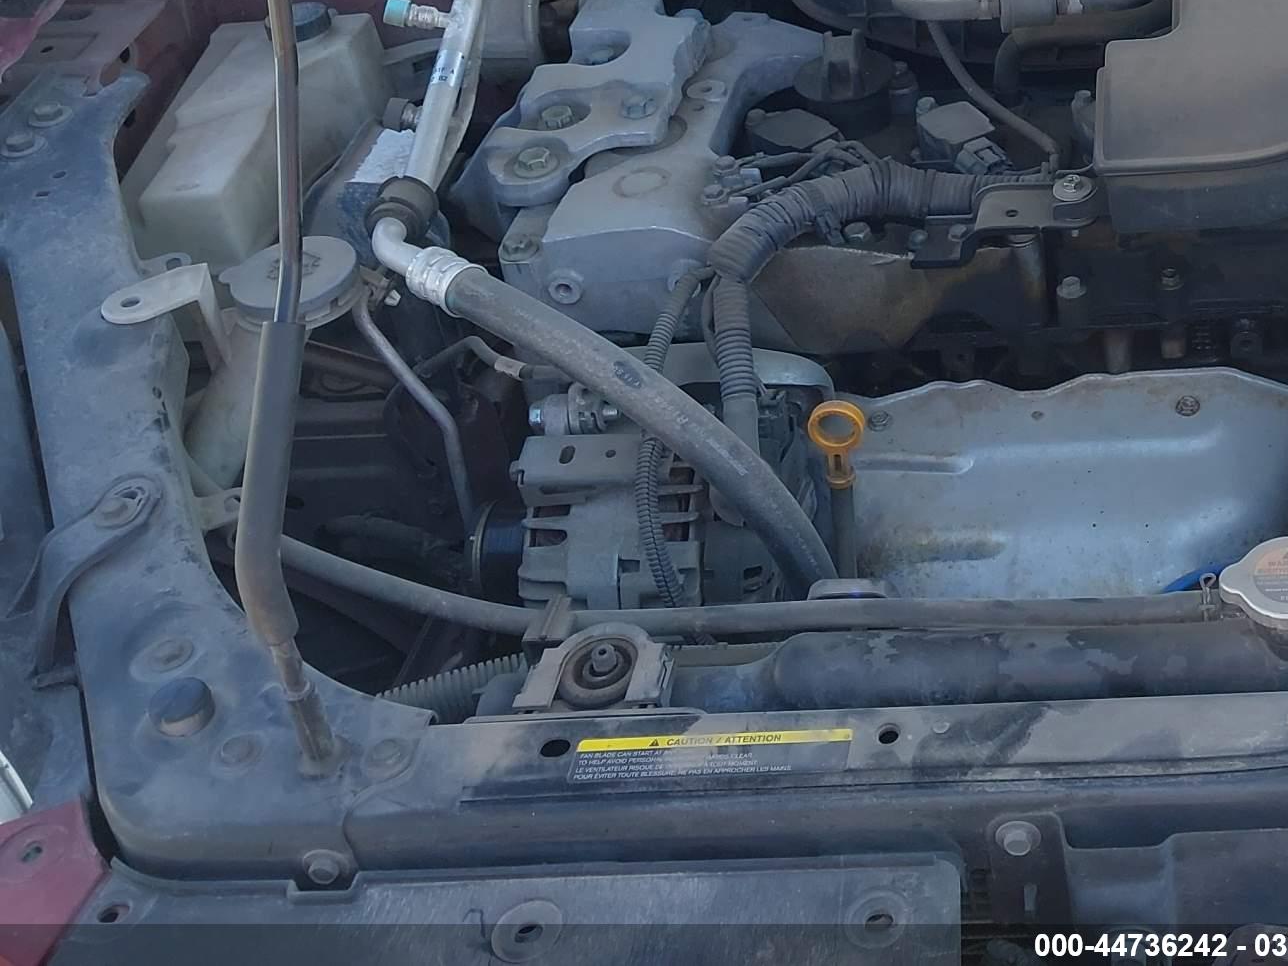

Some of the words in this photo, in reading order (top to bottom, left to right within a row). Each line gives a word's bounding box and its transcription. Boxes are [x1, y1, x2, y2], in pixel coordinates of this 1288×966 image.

[666, 738, 712, 747] CAUTION
[724, 733, 782, 745] ATTENTION
[580, 752, 593, 760] FAN
[617, 750, 632, 758] CAN
